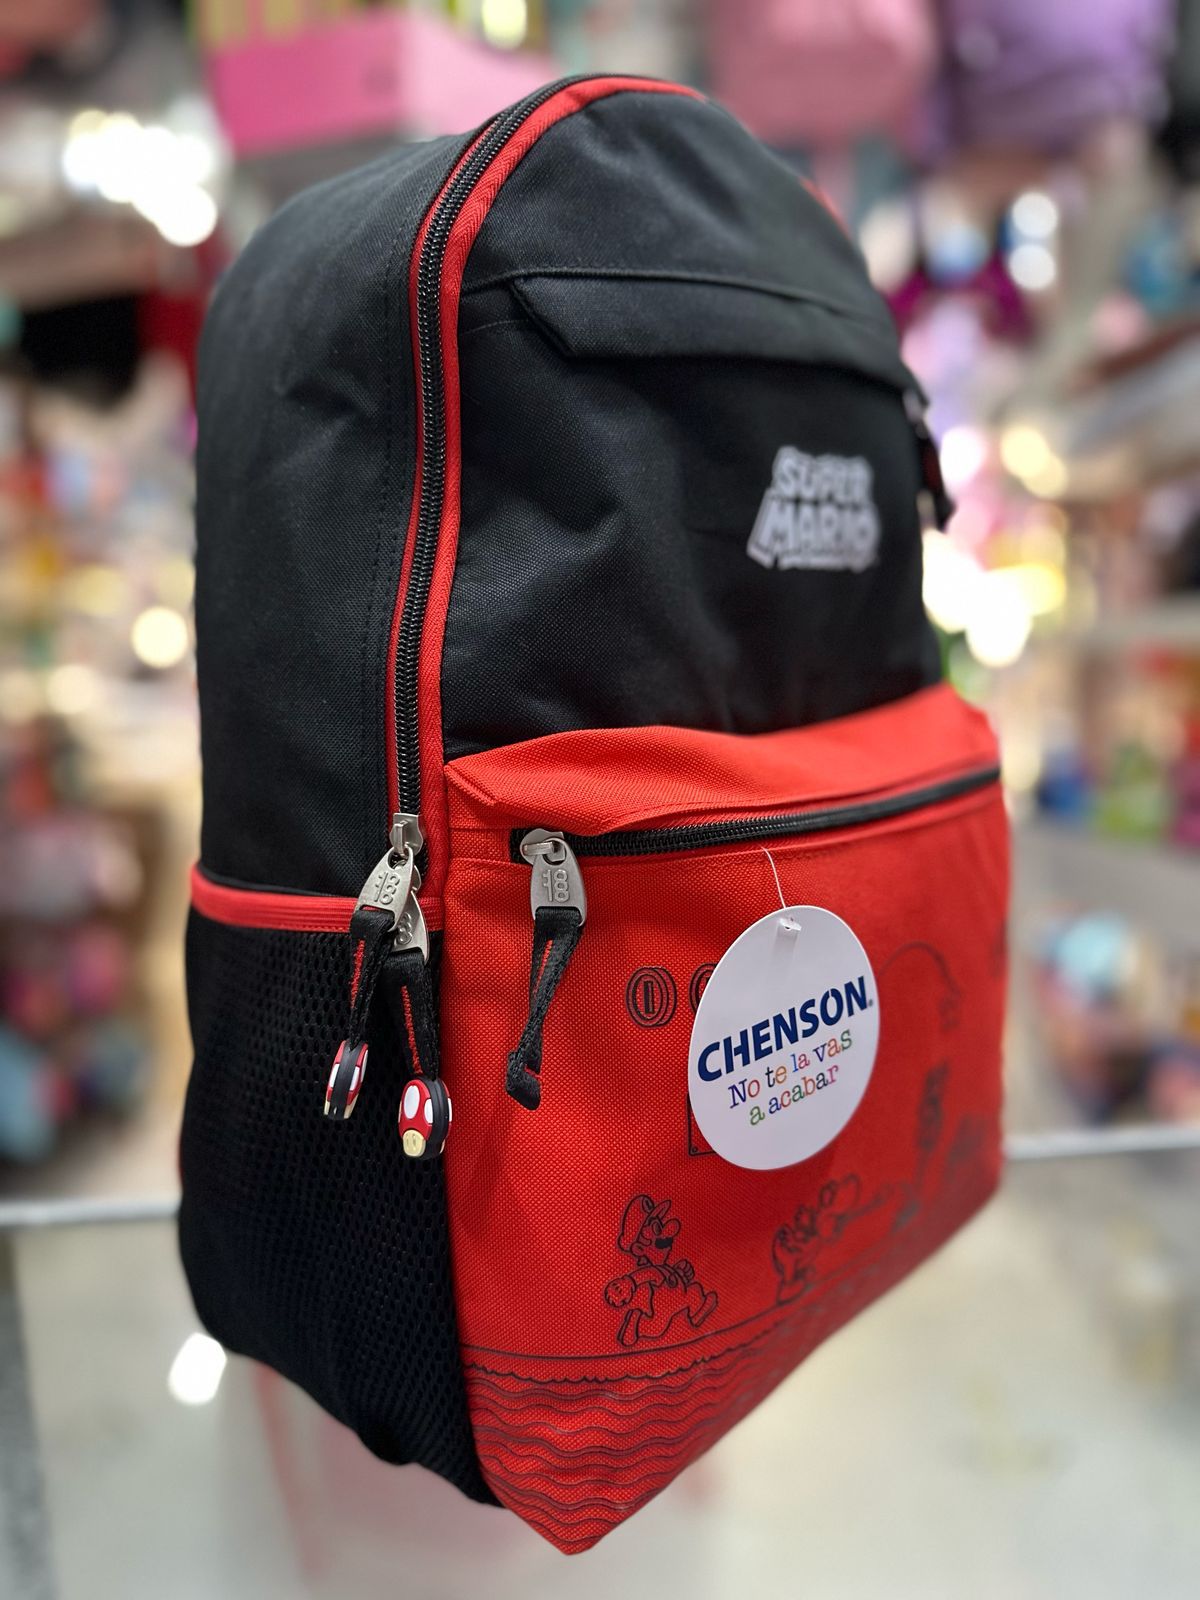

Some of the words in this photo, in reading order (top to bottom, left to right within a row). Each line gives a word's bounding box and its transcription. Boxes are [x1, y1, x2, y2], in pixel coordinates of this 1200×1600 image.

[771, 446, 873, 502] SUPER
[747, 489, 880, 573] MARIO
[727, 1078, 761, 1109] No
[764, 1065, 788, 1088] te
[791, 1053, 811, 1074] la
[814, 1029, 853, 1064] vas
[749, 1104, 766, 1126] a
[767, 1064, 840, 1115] acabar
